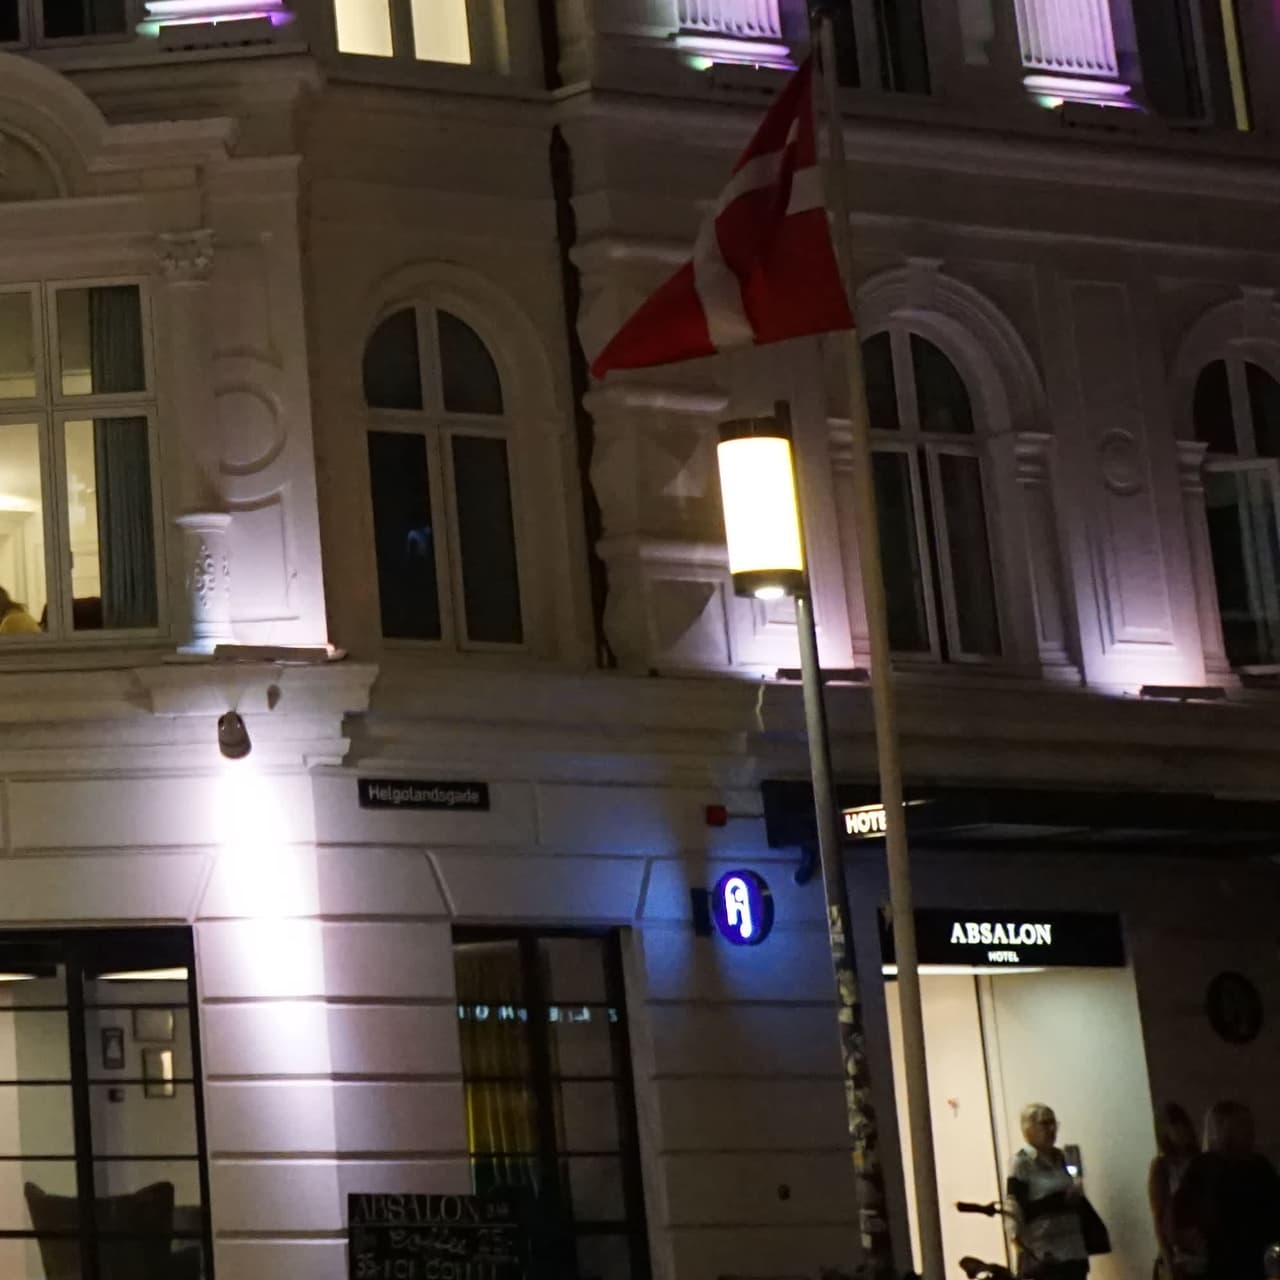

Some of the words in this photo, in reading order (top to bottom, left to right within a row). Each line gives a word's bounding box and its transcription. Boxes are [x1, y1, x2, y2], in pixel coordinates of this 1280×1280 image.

[367, 783, 480, 806] Helgolandsgade
[844, 809, 887, 835] HOTE
[950, 921, 1052, 945] ABSALON
[987, 950, 1021, 962] HOTEL
